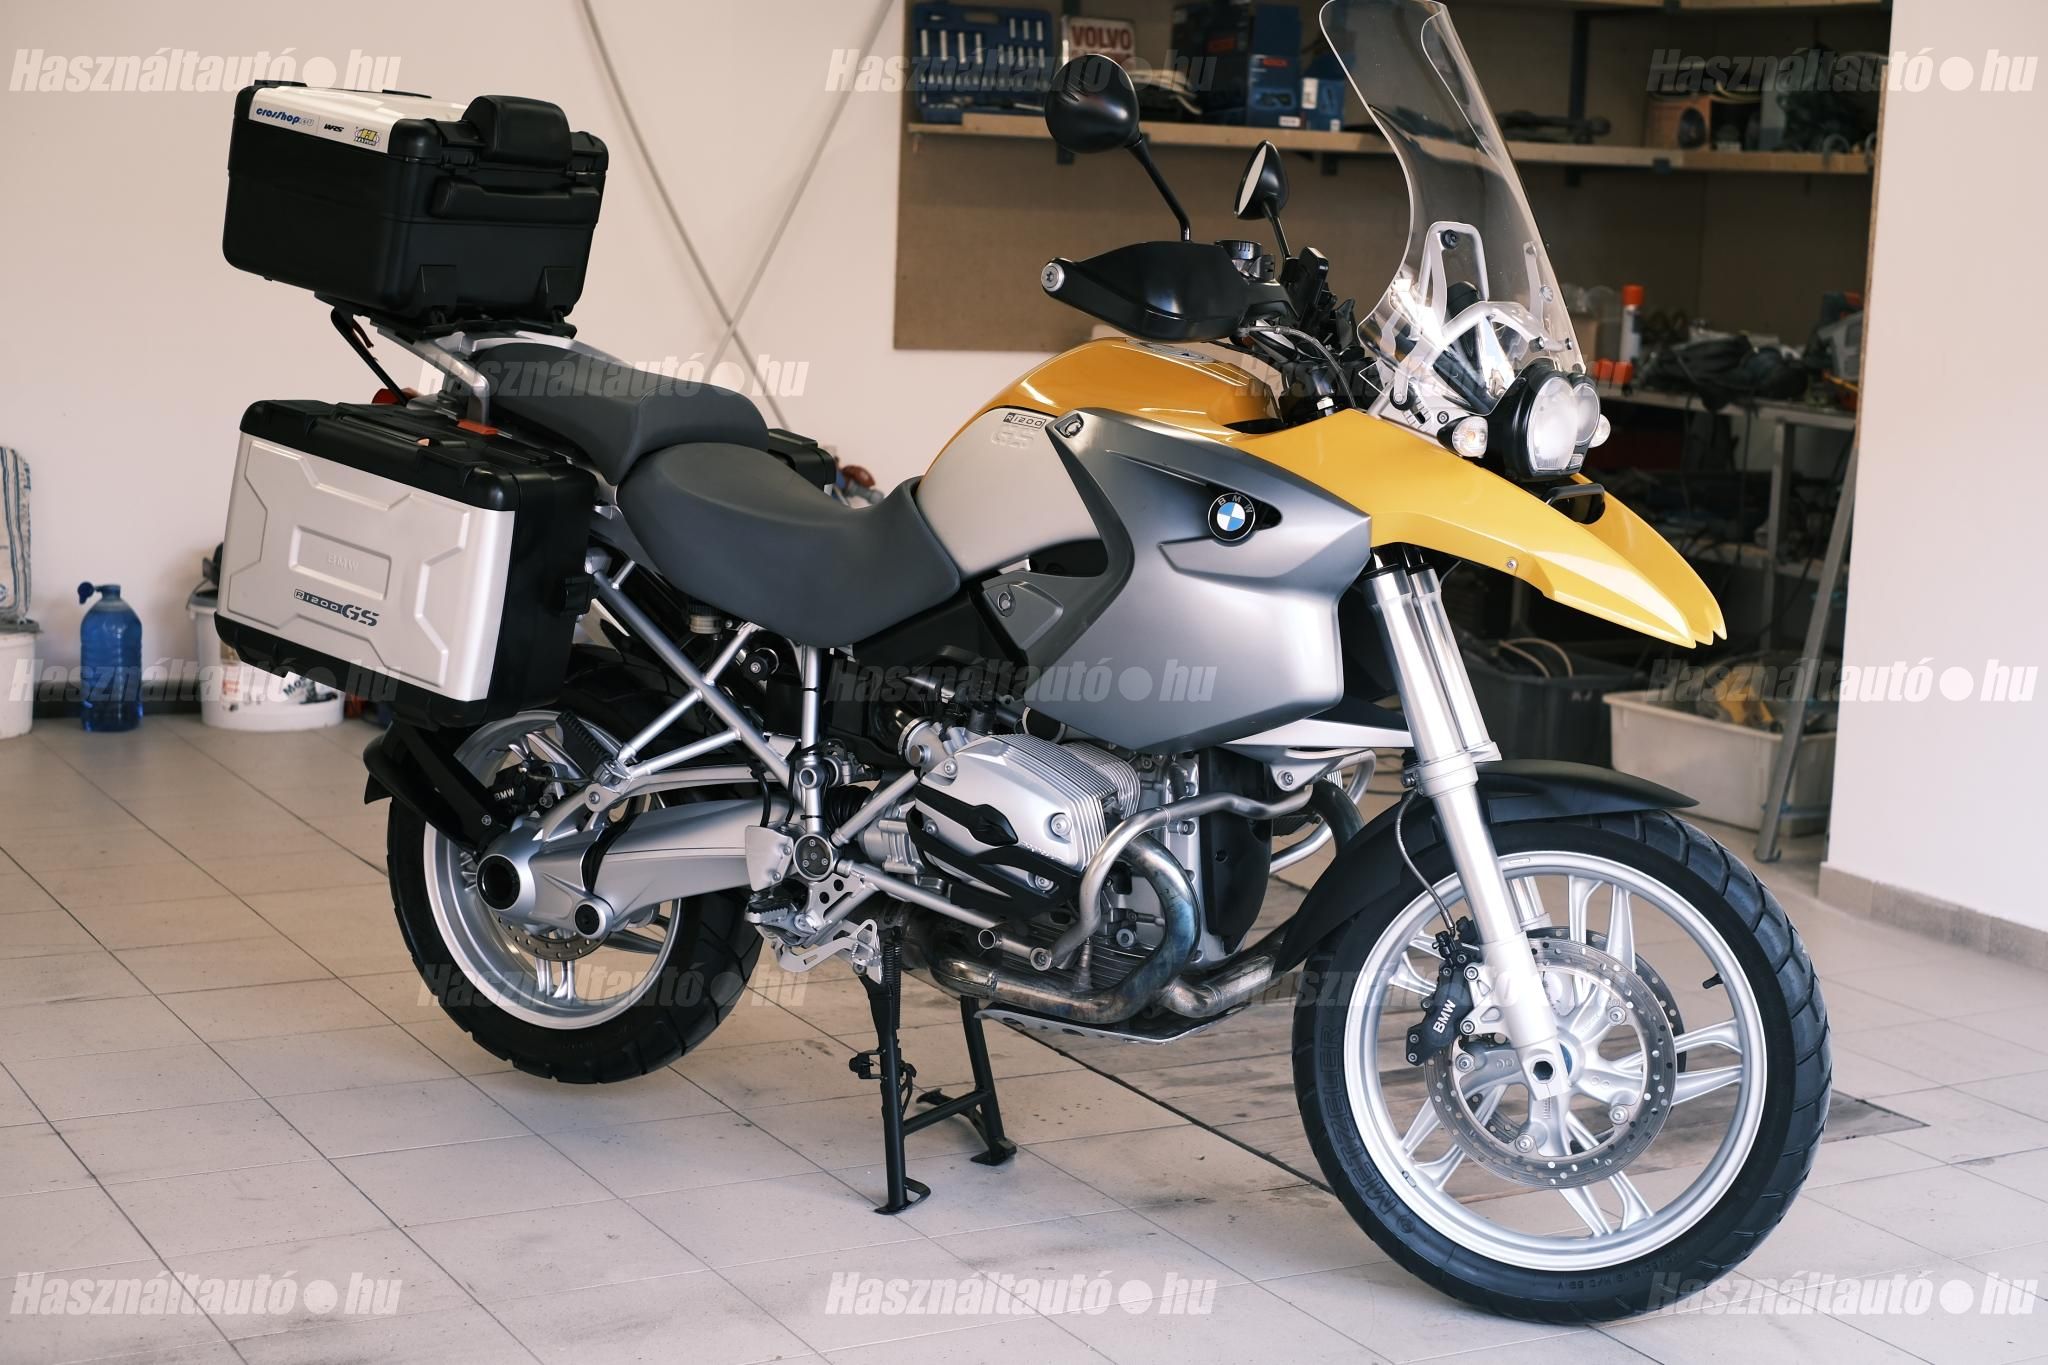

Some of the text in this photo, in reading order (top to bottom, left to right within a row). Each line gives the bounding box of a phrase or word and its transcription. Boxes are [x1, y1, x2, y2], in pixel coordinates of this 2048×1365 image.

[1071, 25, 1132, 50] VOLVO
[1217, 495, 1252, 513] BMW
[327, 552, 359, 571] BMW
[494, 787, 515, 801] BMW
[1432, 999, 1456, 1034] BMW
[1320, 1023, 1398, 1216] METZELER
